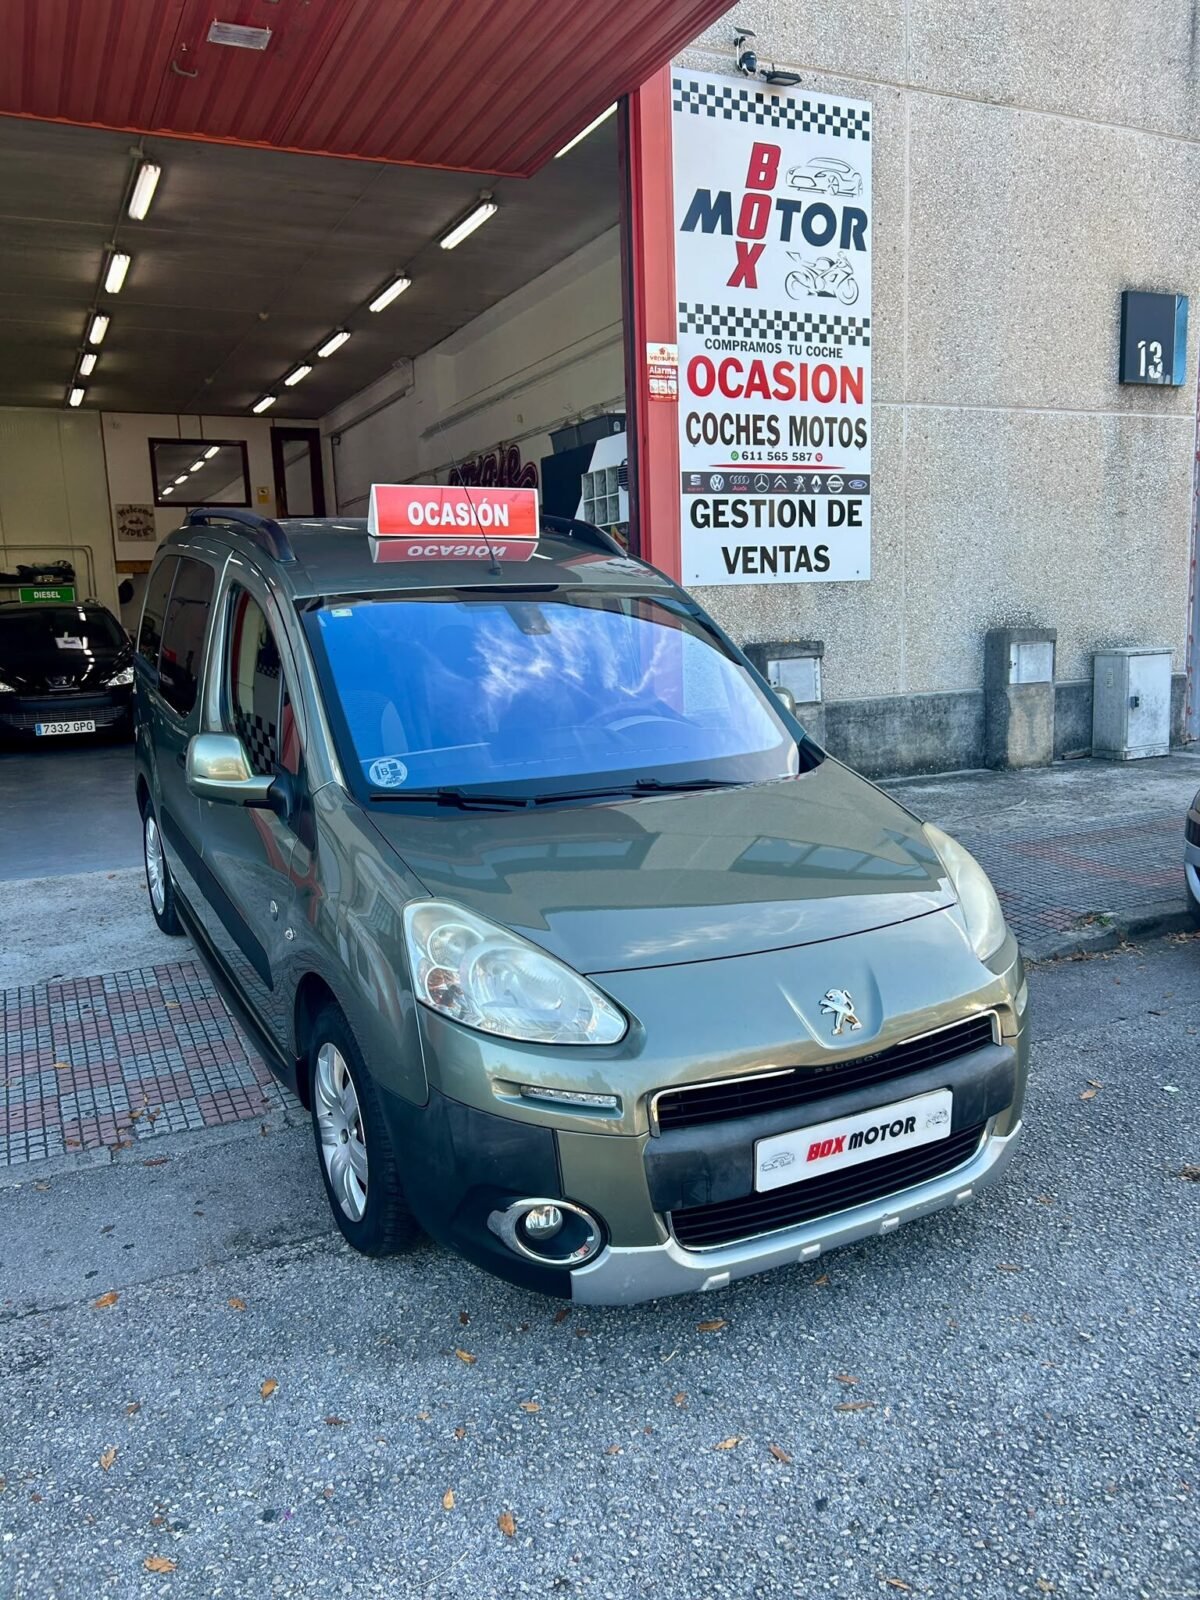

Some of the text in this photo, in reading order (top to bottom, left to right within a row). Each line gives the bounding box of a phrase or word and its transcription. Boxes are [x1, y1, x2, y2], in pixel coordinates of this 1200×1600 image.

[680, 188, 868, 252] MOTOR
[726, 142, 781, 289] BOX
[704, 338, 843, 358] COMPRAMOS TU COCHE
[1137, 340, 1163, 379] 13
[649, 366, 677, 374] Alarma
[687, 355, 863, 404] OCASION
[686, 411, 868, 448] COCHES MOTOS
[741, 451, 812, 461] 611 565 587
[407, 498, 510, 527] OCASIÓN
[690, 498, 863, 528] GESTION DE
[721, 545, 831, 574] VENTAS
[33, 591, 61, 599] DIESEL
[43, 720, 93, 734] 7332 GPG
[815, 1053, 881, 1073] PEUGEOT
[806, 1116, 917, 1162] BOX MOTOR
